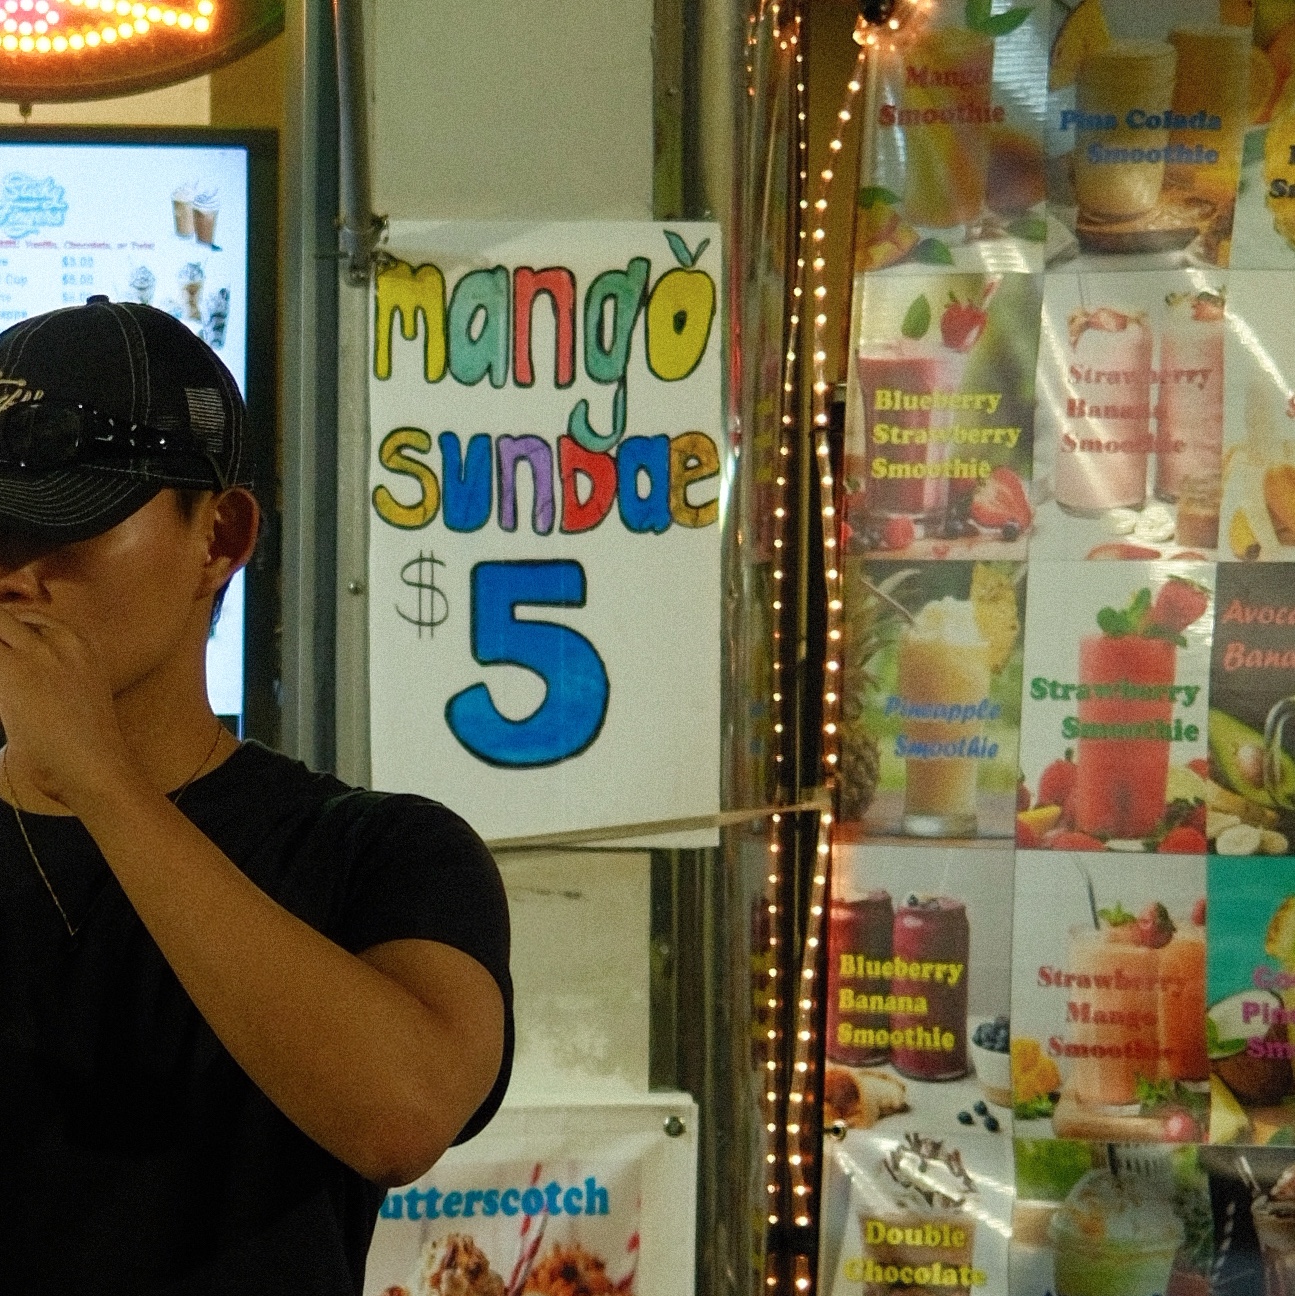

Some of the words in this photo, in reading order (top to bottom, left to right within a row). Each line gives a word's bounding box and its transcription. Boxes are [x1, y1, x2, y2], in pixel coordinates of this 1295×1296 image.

[906, 64, 989, 88] Mango
[1125, 108, 1222, 131] Colada
[1087, 142, 1221, 165] Smoothie
[1068, 363, 1212, 390] Strawberry
[873, 389, 1004, 414] Blueberry
[871, 423, 1023, 449] Strawberry
[870, 457, 992, 480] Smoothie
[1030, 676, 1202, 707] Strawberry
[883, 695, 1002, 725] Pineapple
[1061, 716, 1201, 742] Smoothie
[894, 734, 1000, 760] Smoothie
[839, 953, 965, 987] Blueberry
[1037, 965, 1191, 997] Strawberry
[838, 987, 929, 1016] Banana
[1065, 1001, 1159, 1028] Mango
[836, 1023, 956, 1051] Smoothie
[1047, 1036, 1177, 1060] Smoothie
[379, 1176, 610, 1221] utterscotch
[865, 1219, 968, 1249] Double
[843, 1257, 988, 1289] Chocolate
